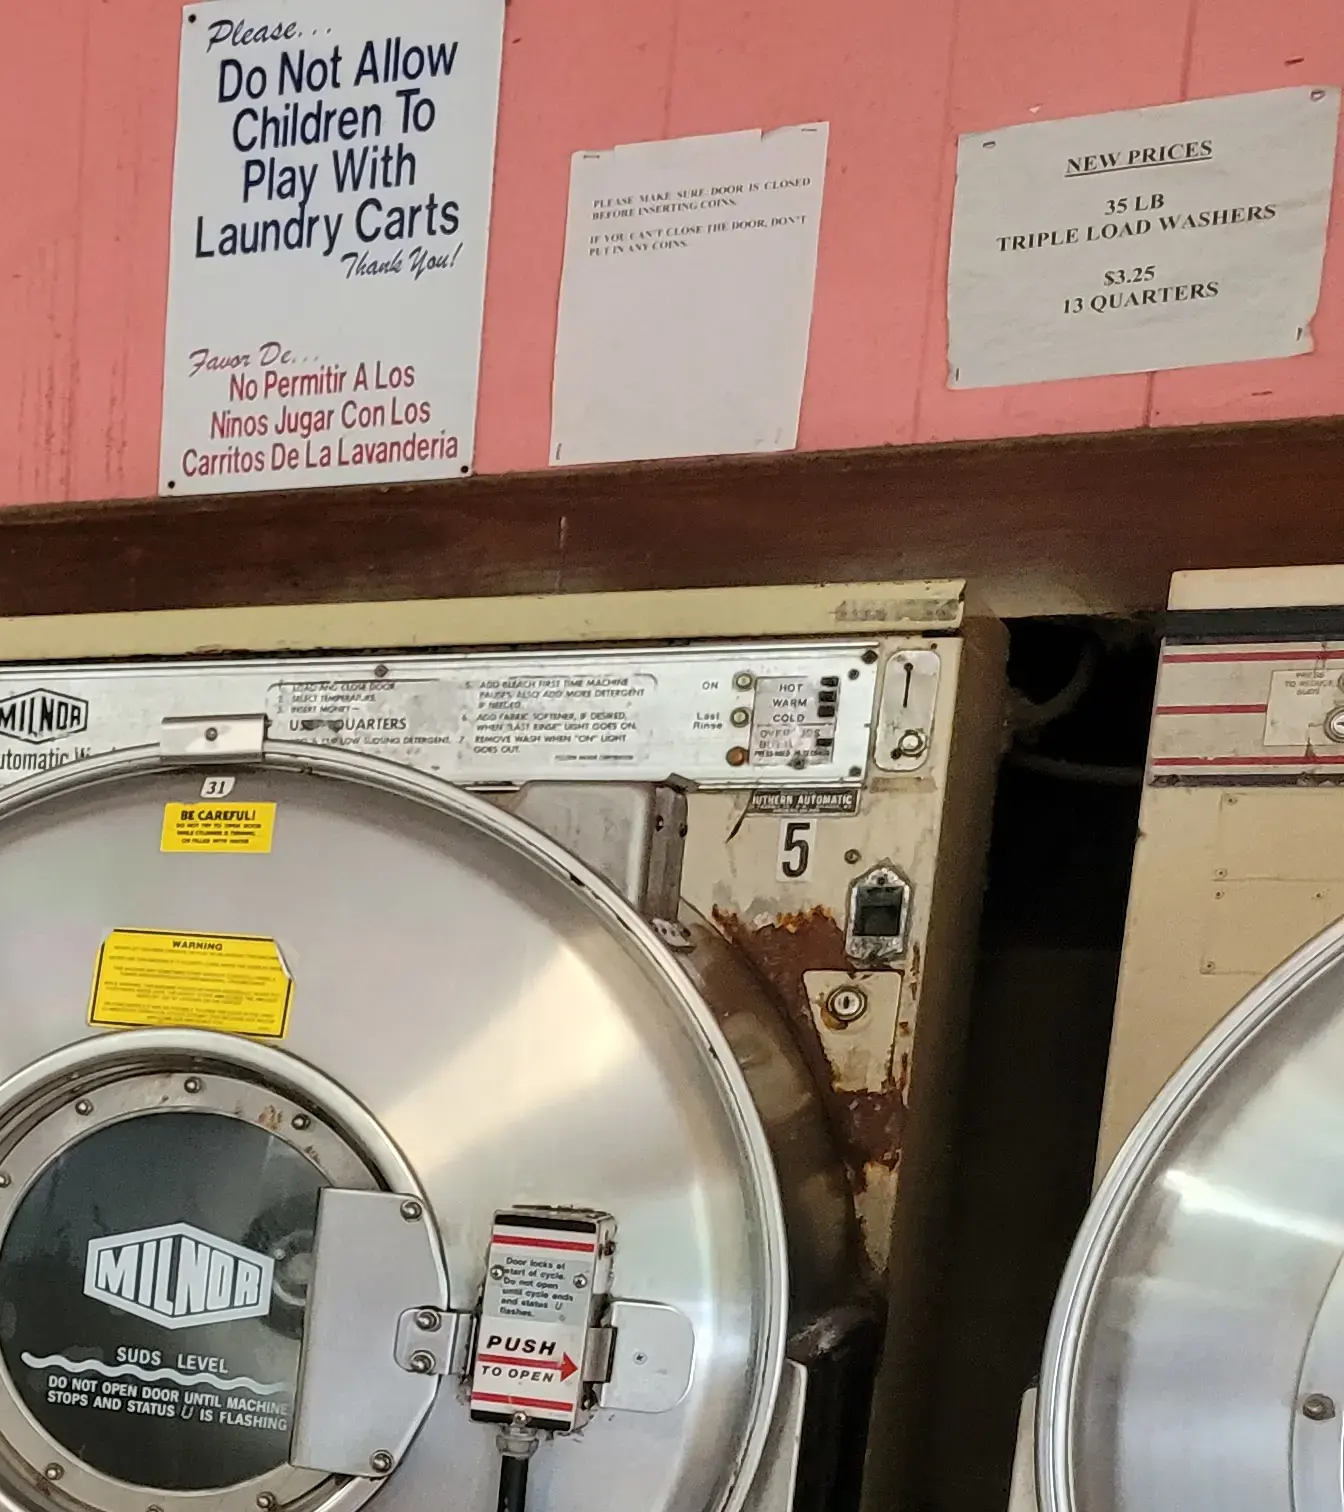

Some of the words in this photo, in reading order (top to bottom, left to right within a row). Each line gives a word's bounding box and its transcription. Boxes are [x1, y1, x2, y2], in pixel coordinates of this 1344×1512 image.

[207, 19, 332, 53] Please...
[218, 59, 267, 103] Do
[278, 46, 342, 96] Not
[354, 37, 459, 87] Allow
[233, 100, 382, 152] Children
[396, 88, 435, 134] To
[1067, 152, 1120, 174] NEW
[1128, 140, 1213, 164] PRICES
[243, 157, 318, 209] Play
[332, 143, 416, 193] With
[594, 196, 634, 208] PLEASE
[640, 192, 671, 203] MAKE
[677, 189, 704, 198] SURE
[711, 185, 743, 196] DOOR
[749, 183, 759, 192] IS
[764, 178, 811, 190] CLOSED
[1105, 198, 1128, 216] 35
[1134, 193, 1164, 212] LB
[592, 205, 634, 220] BEFORE
[638, 199, 697, 216] INSERTING
[196, 201, 343, 258] Laundry
[355, 193, 459, 242] Carts
[590, 236, 599, 244] IF
[605, 232, 624, 242] YOU
[666, 226, 702, 237] CLOSE
[707, 223, 728, 233] THE
[771, 215, 806, 227] DON'T
[997, 228, 1079, 252] TRIPLE
[1086, 220, 1151, 241] LOAD
[1159, 204, 1276, 231] WASHERS
[340, 249, 404, 279] Thank
[408, 242, 463, 280] You!
[589, 247, 609, 256] PUT
[613, 245, 624, 254] IN
[629, 243, 648, 253] ANY
[1103, 265, 1156, 287] $3.25
[1063, 297, 1083, 314] 13
[1090, 281, 1219, 313] QUARTERS
[188, 348, 252, 377] Favor
[230, 373, 257, 402] No
[264, 365, 347, 400] Permitir
[353, 362, 368, 391] A
[375, 360, 415, 389] Los
[210, 410, 269, 439] Ninos
[275, 405, 334, 439] Jugar
[341, 400, 384, 429] Con
[391, 396, 431, 425] Los
[182, 445, 265, 477] Carritos
[271, 442, 300, 470] De
[305, 440, 331, 468] La
[338, 429, 458, 466] Lavanderia
[702, 680, 719, 690] ON
[779, 683, 804, 693] HOT
[696, 712, 720, 721] Last
[772, 699, 807, 707] WARM
[693, 721, 723, 730] Rinse
[772, 714, 805, 723] COLD
[206, 780, 225, 795] 31
[798, 794, 853, 805] AUTOMATIC
[181, 810, 194, 820] BE
[198, 810, 256, 821] CAREFUL!
[782, 822, 810, 877] 5
[172, 939, 223, 951] WARNING
[96, 1233, 264, 1318] MILNOR
[503, 1276, 516, 1285] Do
[486, 1334, 557, 1356] PUSH
[116, 1346, 162, 1366] SUDS
[177, 1353, 229, 1374] LEVEL
[481, 1365, 502, 1377] TO
[508, 1368, 554, 1383] OPEN
[48, 1374, 67, 1389] DO
[71, 1377, 98, 1392] NOT
[102, 1380, 137, 1397] OPEN
[142, 1385, 179, 1402] DOOR
[184, 1390, 222, 1408] UNTIL
[227, 1396, 288, 1416] MACHINE
[47, 1391, 89, 1407] STOPS
[92, 1397, 121, 1411] AND
[126, 1401, 175, 1418] STATUS
[199, 1409, 213, 1422] IS
[219, 1411, 288, 1431] FLASHING
